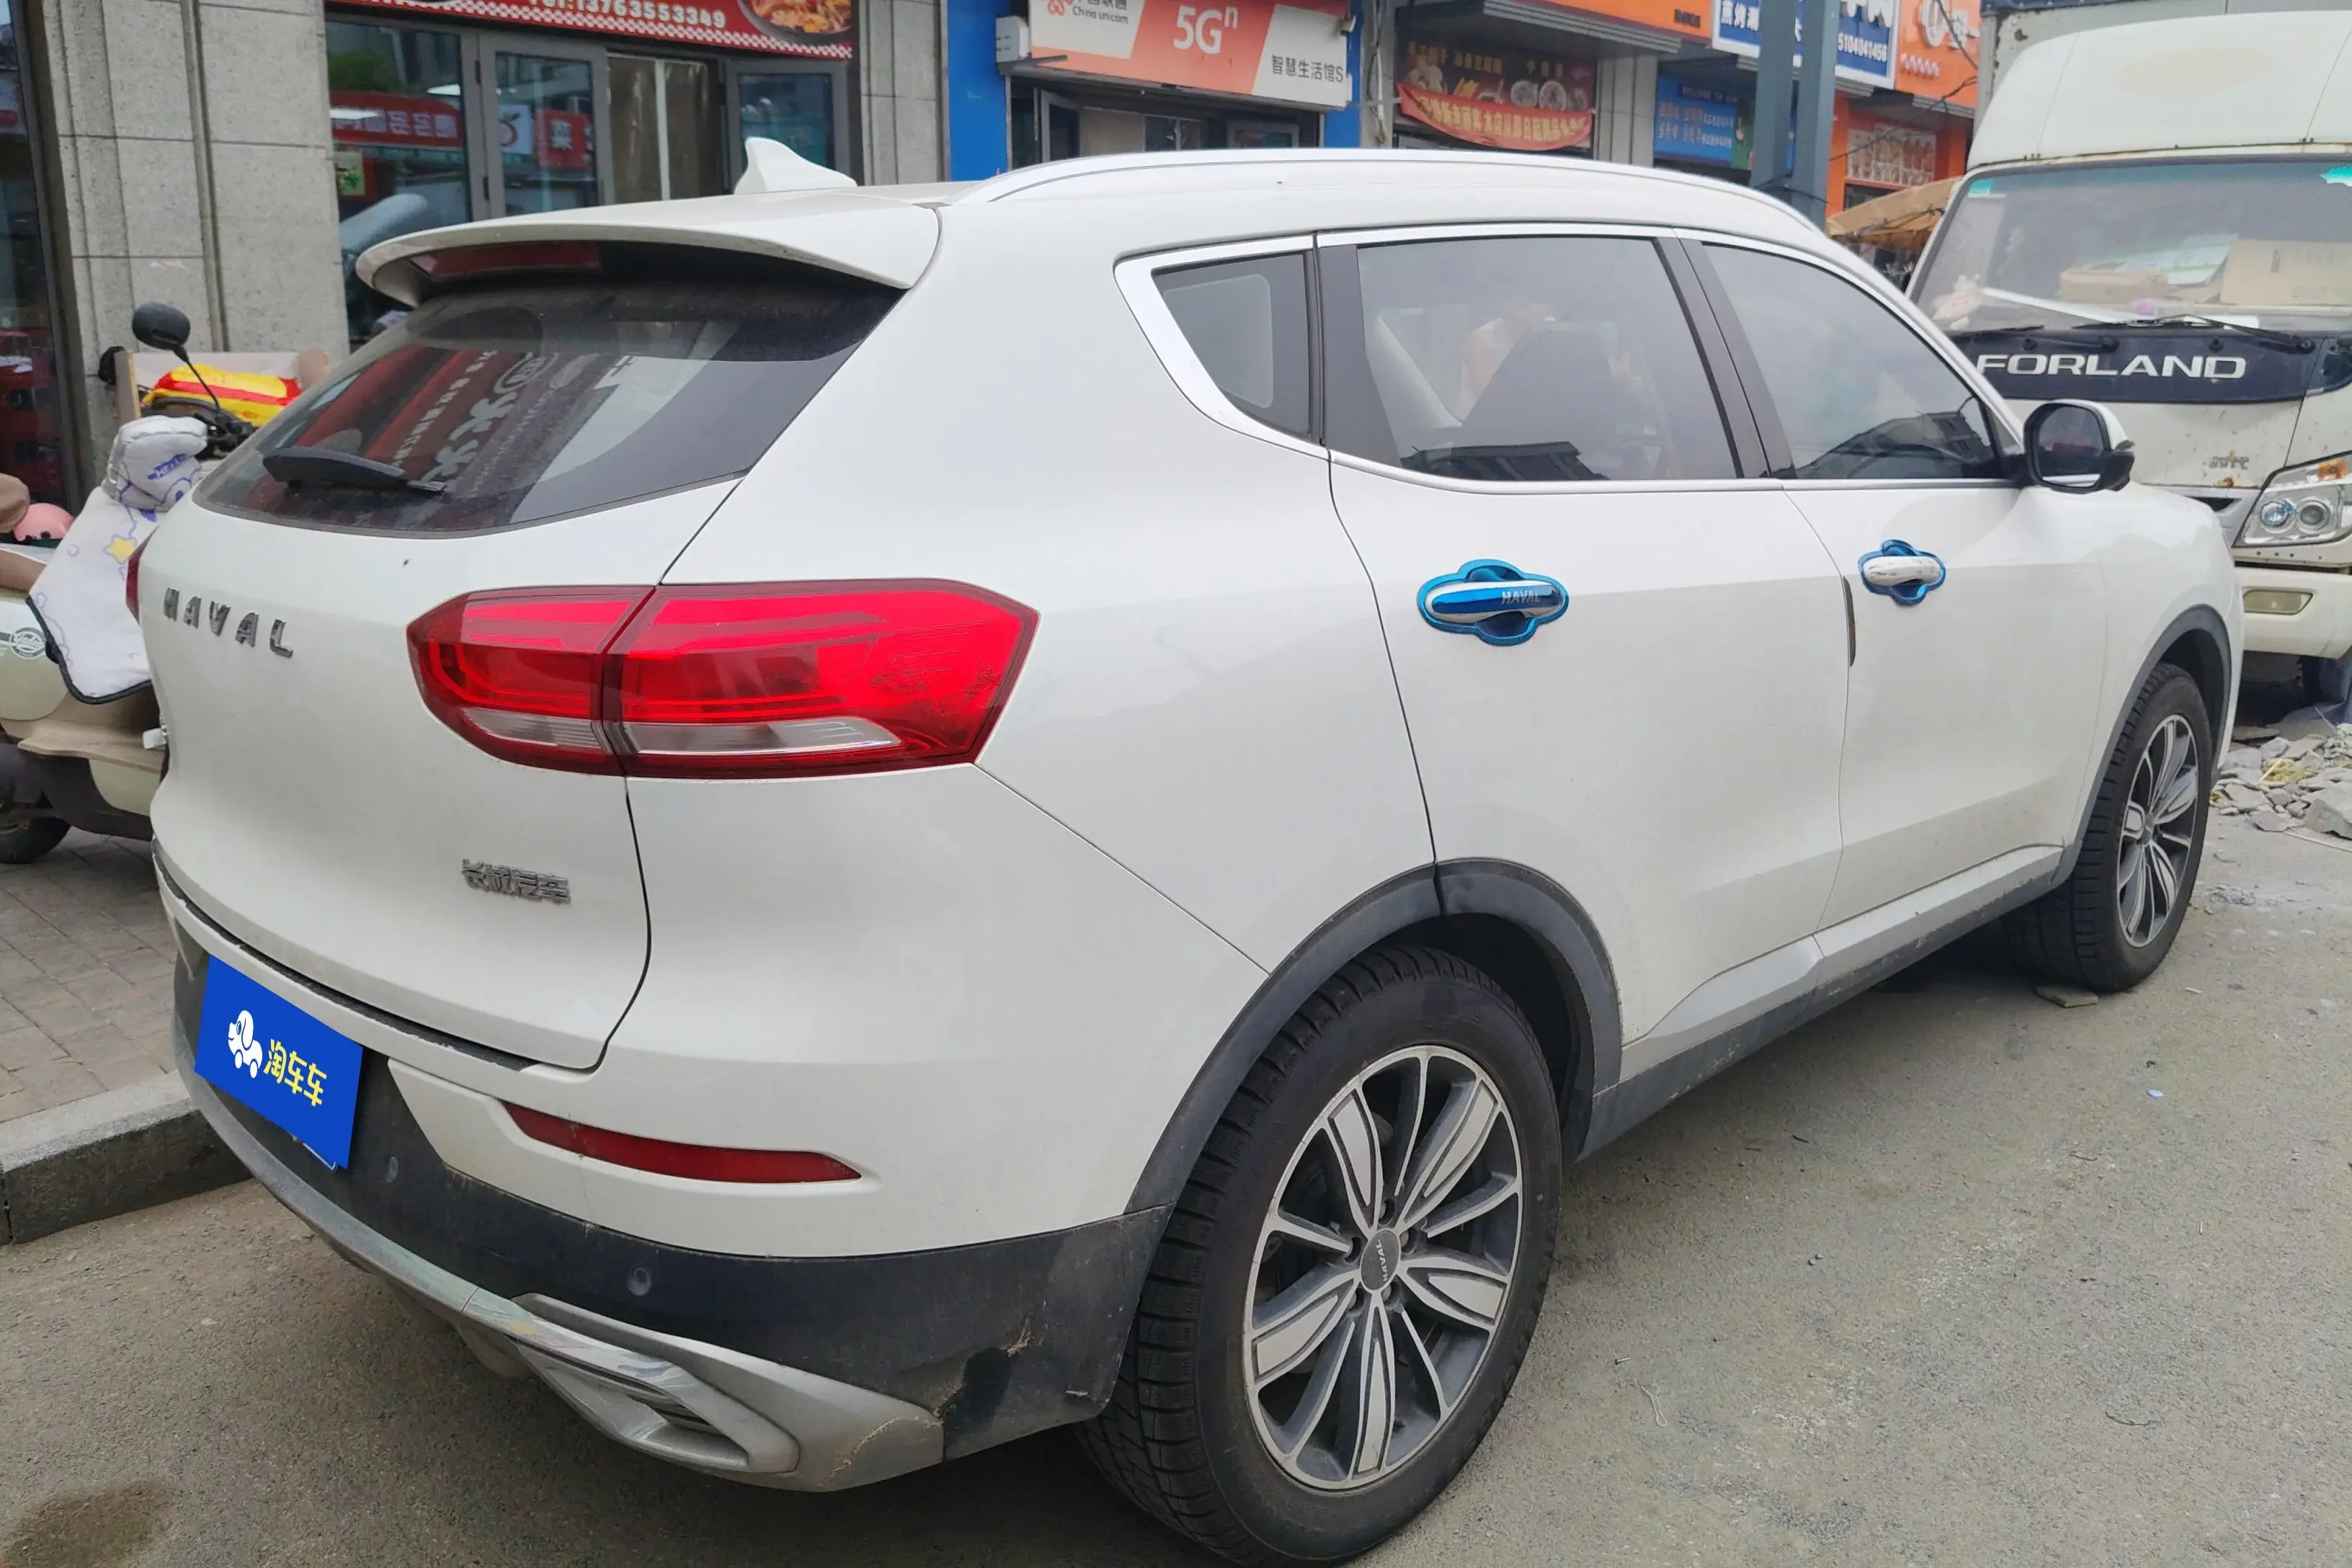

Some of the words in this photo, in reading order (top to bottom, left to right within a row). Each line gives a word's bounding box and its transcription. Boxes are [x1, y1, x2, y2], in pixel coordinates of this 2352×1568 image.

[1977, 353, 2247, 380] FORLAND
[1500, 589, 1540, 605] HAVAL
[164, 587, 294, 659] HAVAL
[1375, 1239, 1389, 1282] HAVAL
